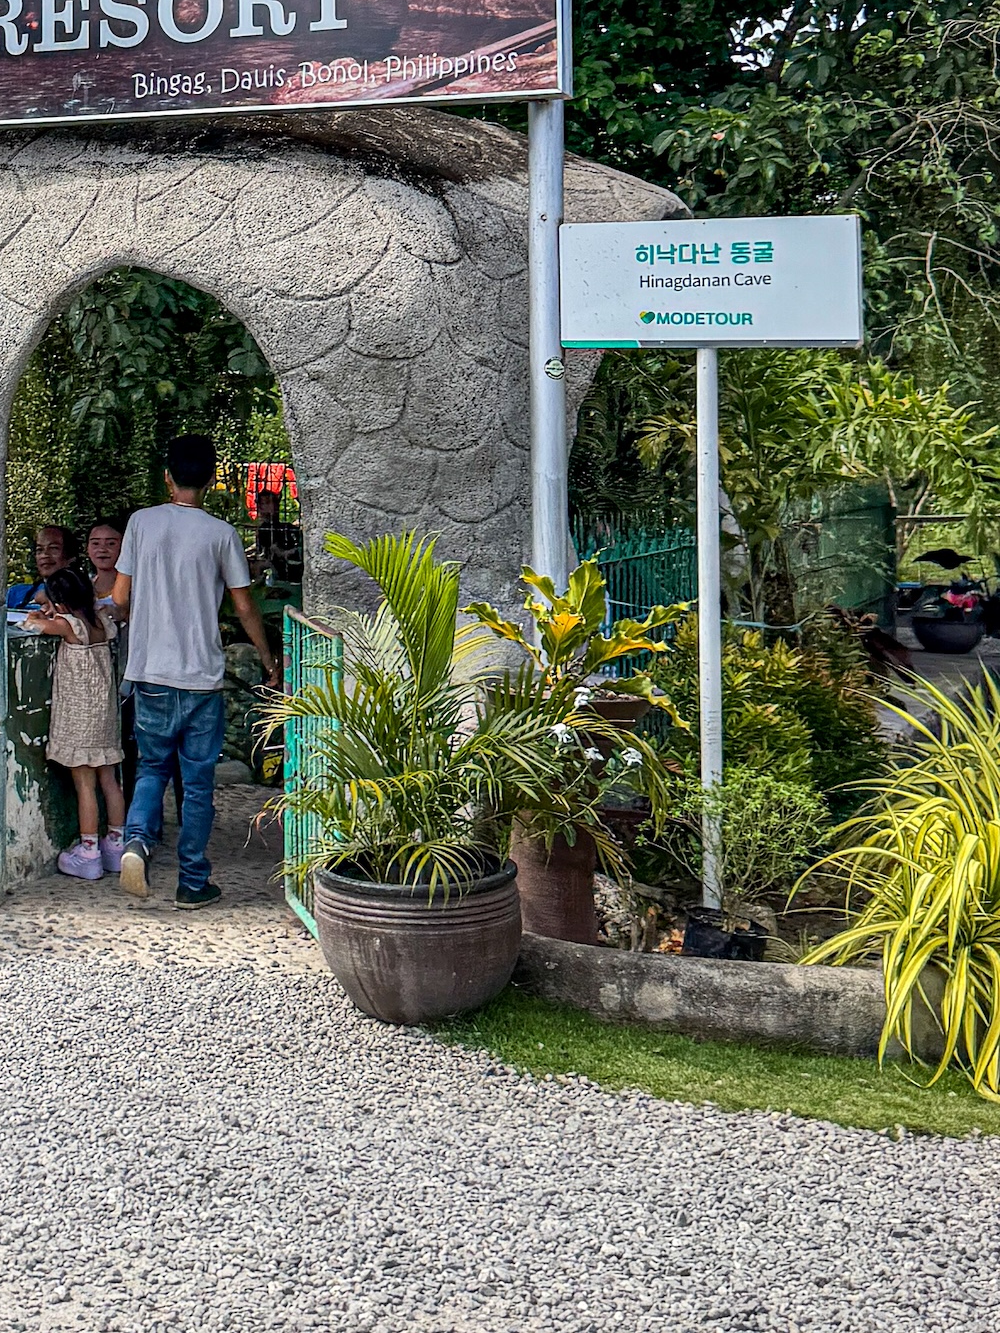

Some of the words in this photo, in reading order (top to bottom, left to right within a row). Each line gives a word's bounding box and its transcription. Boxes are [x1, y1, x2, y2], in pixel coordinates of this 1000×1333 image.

[132, 71, 212, 99] Bingag,
[220, 65, 292, 91] Dauis,
[384, 50, 519, 83] Philippines
[635, 243, 722, 265] 히낙다난
[730, 241, 775, 263] 동굴
[639, 273, 731, 291] Hinagdanan
[734, 272, 772, 286] Cave
[656, 311, 753, 326] MODETOUR
